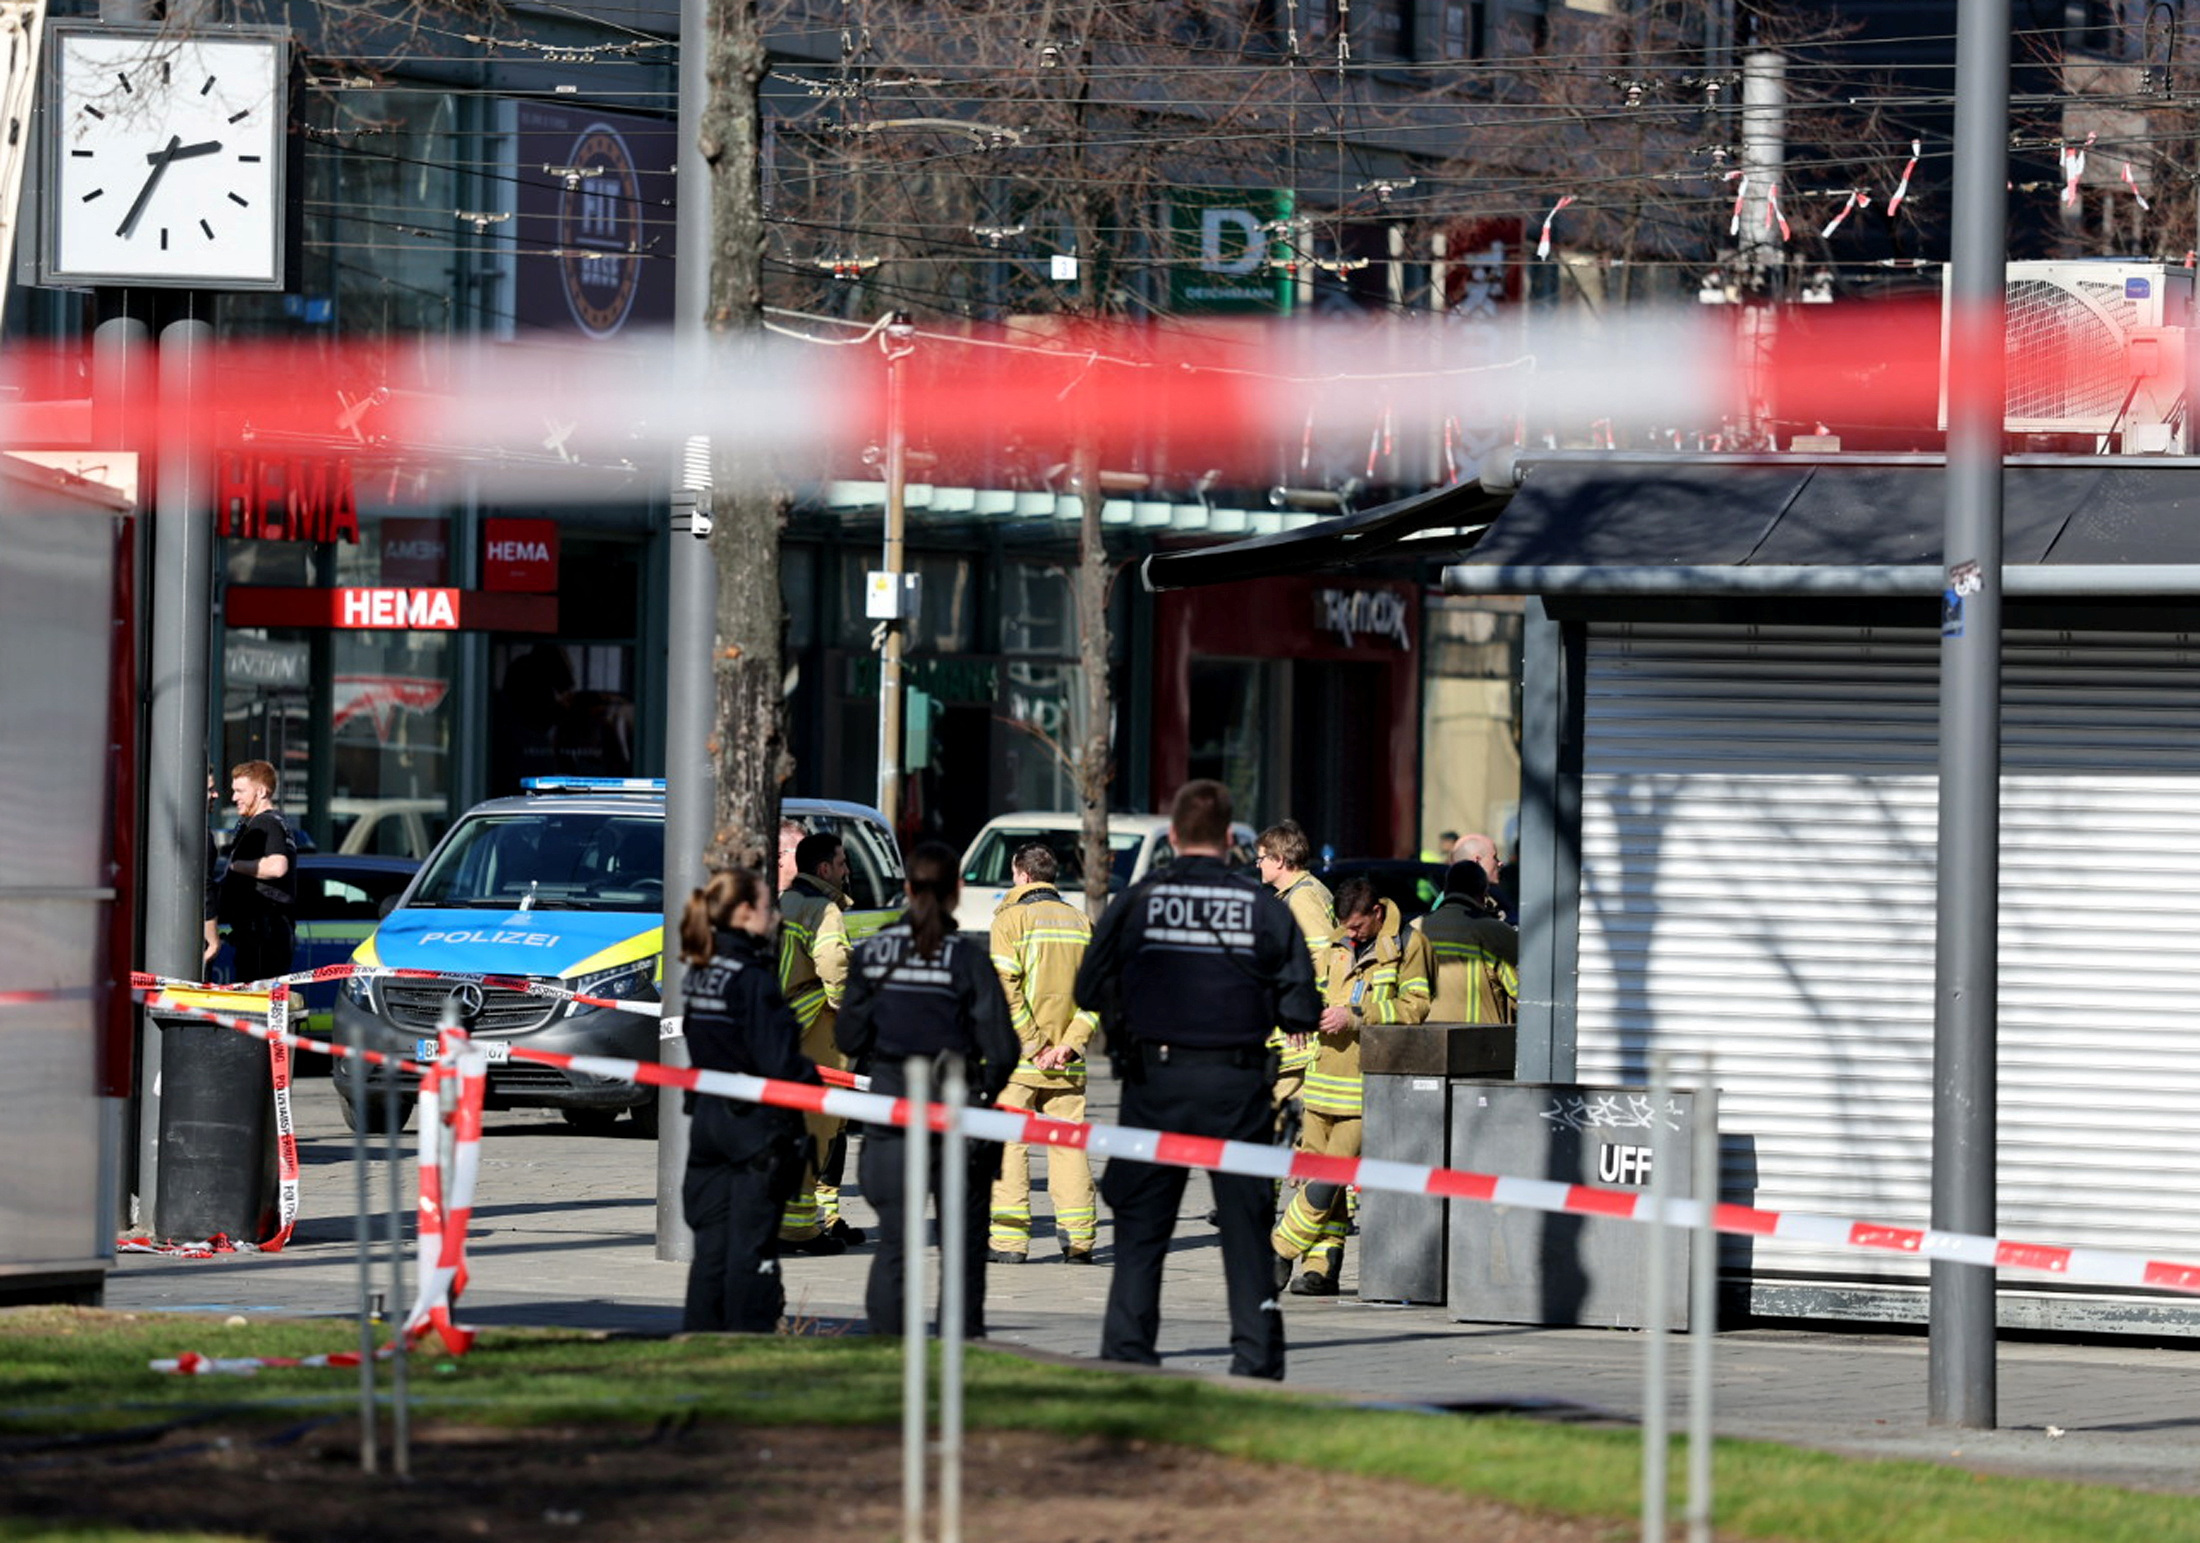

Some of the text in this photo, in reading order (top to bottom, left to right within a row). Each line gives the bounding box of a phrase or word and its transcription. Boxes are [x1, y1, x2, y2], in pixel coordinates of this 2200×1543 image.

[1201, 208, 1266, 277] D
[218, 453, 360, 544] HEMA
[487, 541, 549, 562] HEMA
[344, 589, 456, 626] HEMA
[418, 930, 561, 948] POLIZEI
[1601, 1144, 1653, 1185] UFF
